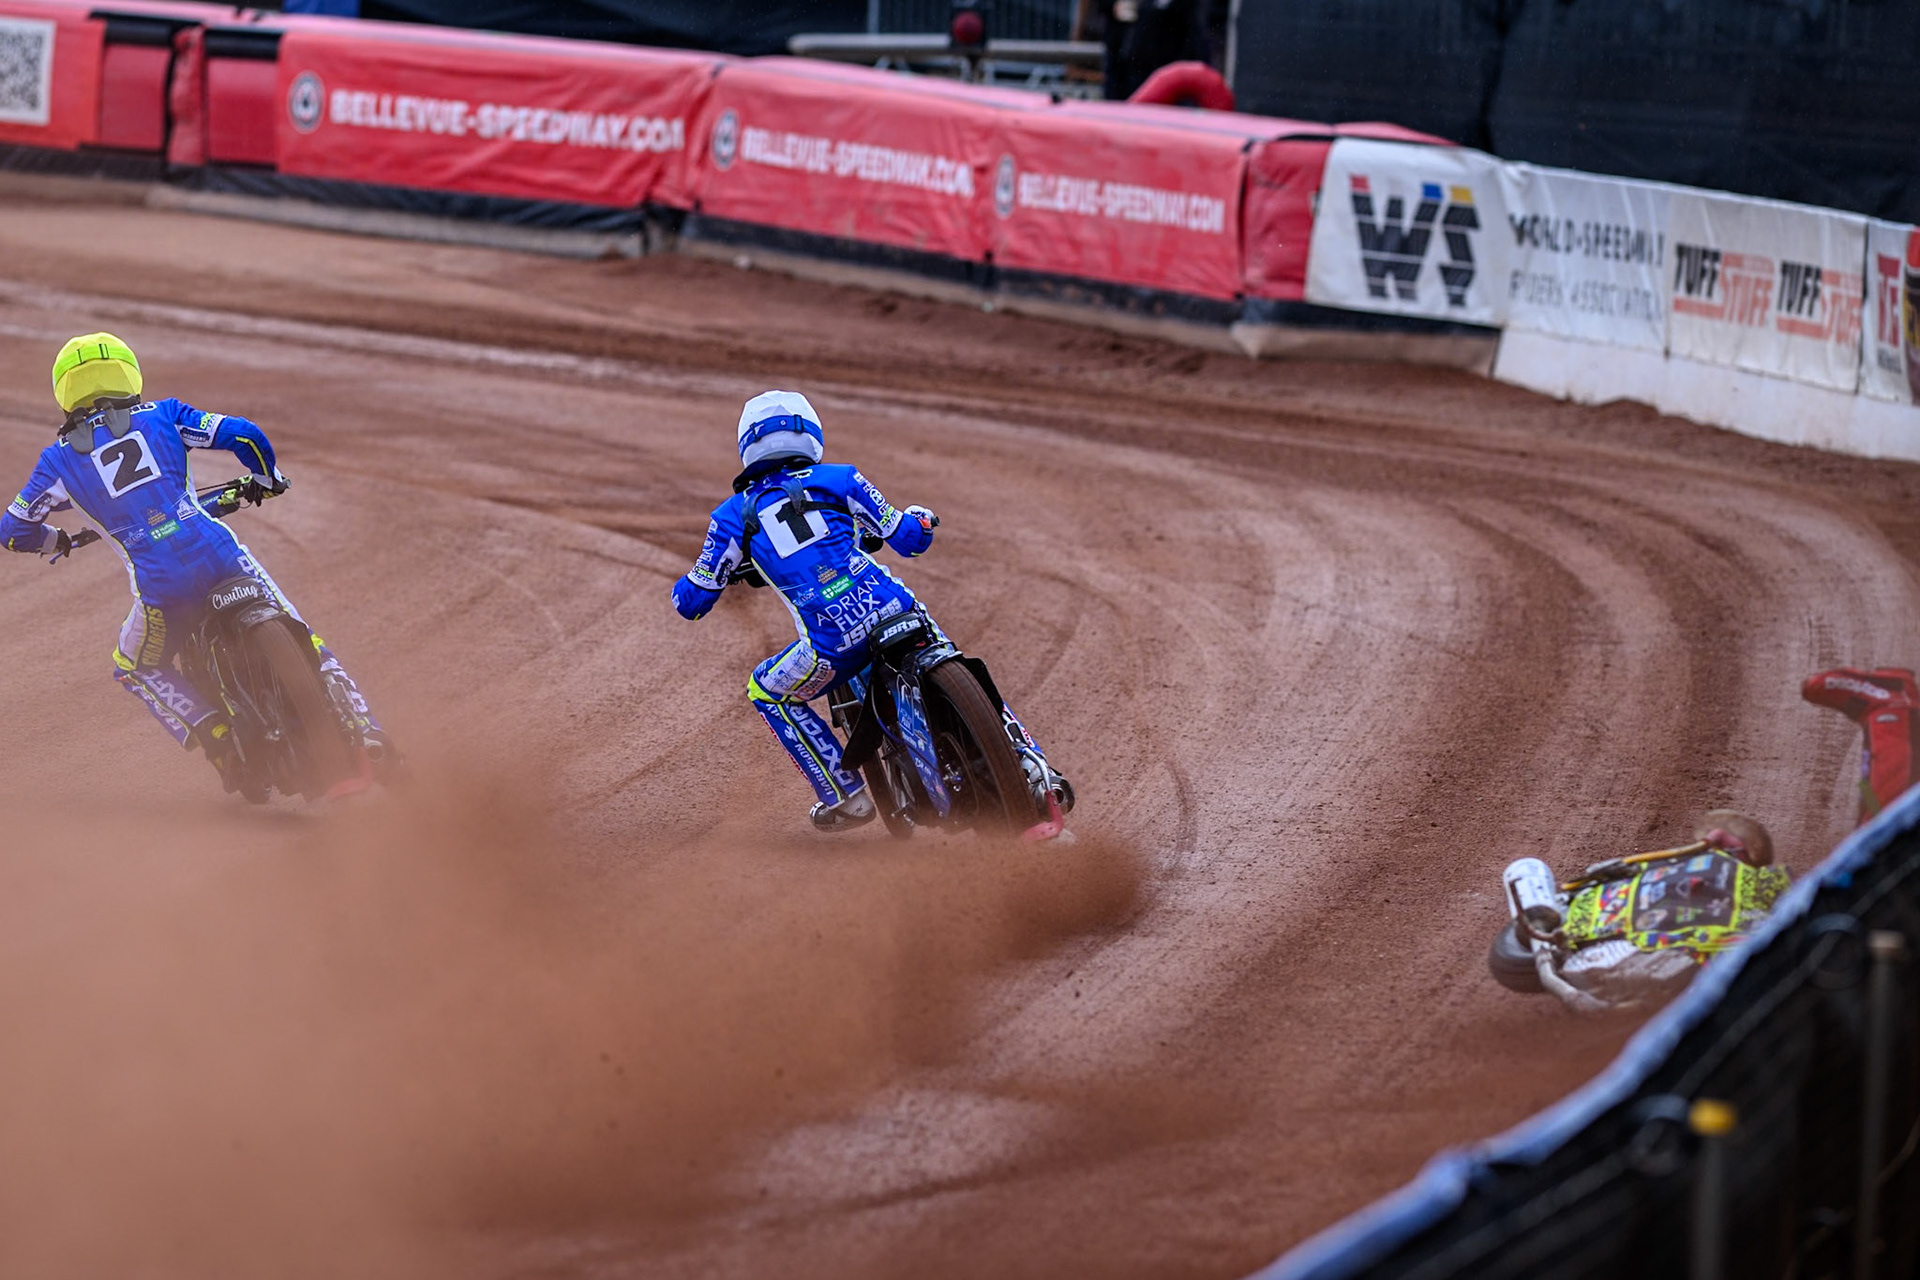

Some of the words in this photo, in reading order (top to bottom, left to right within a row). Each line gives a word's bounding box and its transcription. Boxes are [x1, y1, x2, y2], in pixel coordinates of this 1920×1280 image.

[1019, 172, 1225, 233] BELLEVUE-SPEEDWAY.COM
[1676, 243, 1721, 298] TUFF
[1779, 261, 1822, 317] TUFF
[100, 438, 153, 492] 2
[777, 498, 816, 545] 1
[211, 585, 258, 610] Clouting
[816, 574, 880, 626] ADRIAN
[835, 593, 881, 632] FLUX
[836, 609, 881, 653] JSR
[879, 621, 909, 643] JSR
[788, 702, 855, 786] OXFOR
[794, 743, 834, 796] HARRISON
